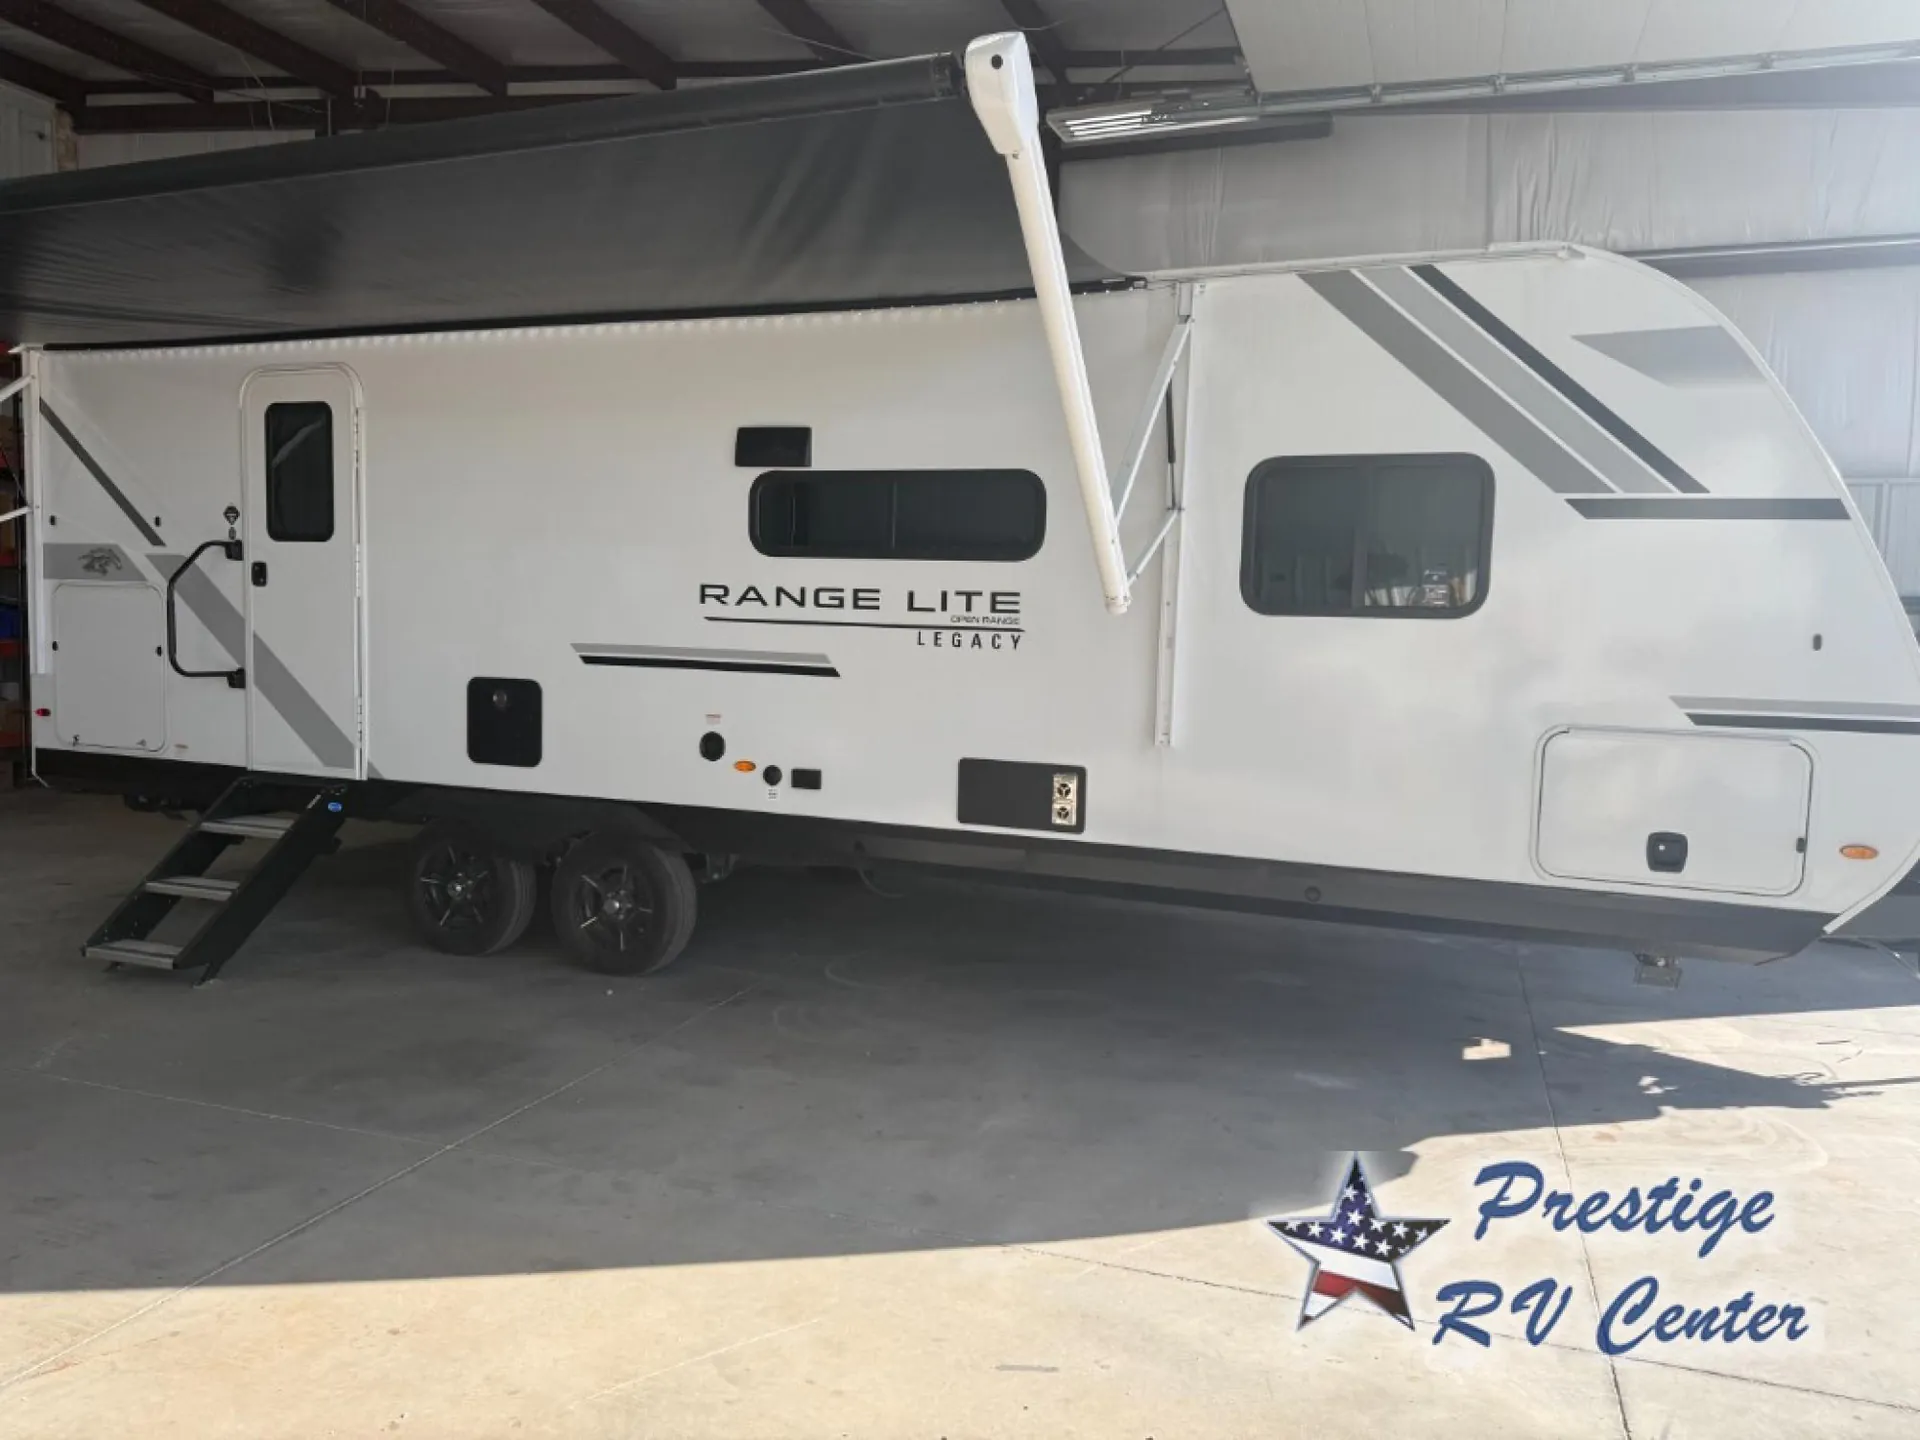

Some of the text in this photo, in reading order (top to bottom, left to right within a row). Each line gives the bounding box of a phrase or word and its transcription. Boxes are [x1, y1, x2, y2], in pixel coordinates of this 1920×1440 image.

[699, 584, 1021, 614] RANGE LITE
[917, 631, 1021, 650] LEGACY
